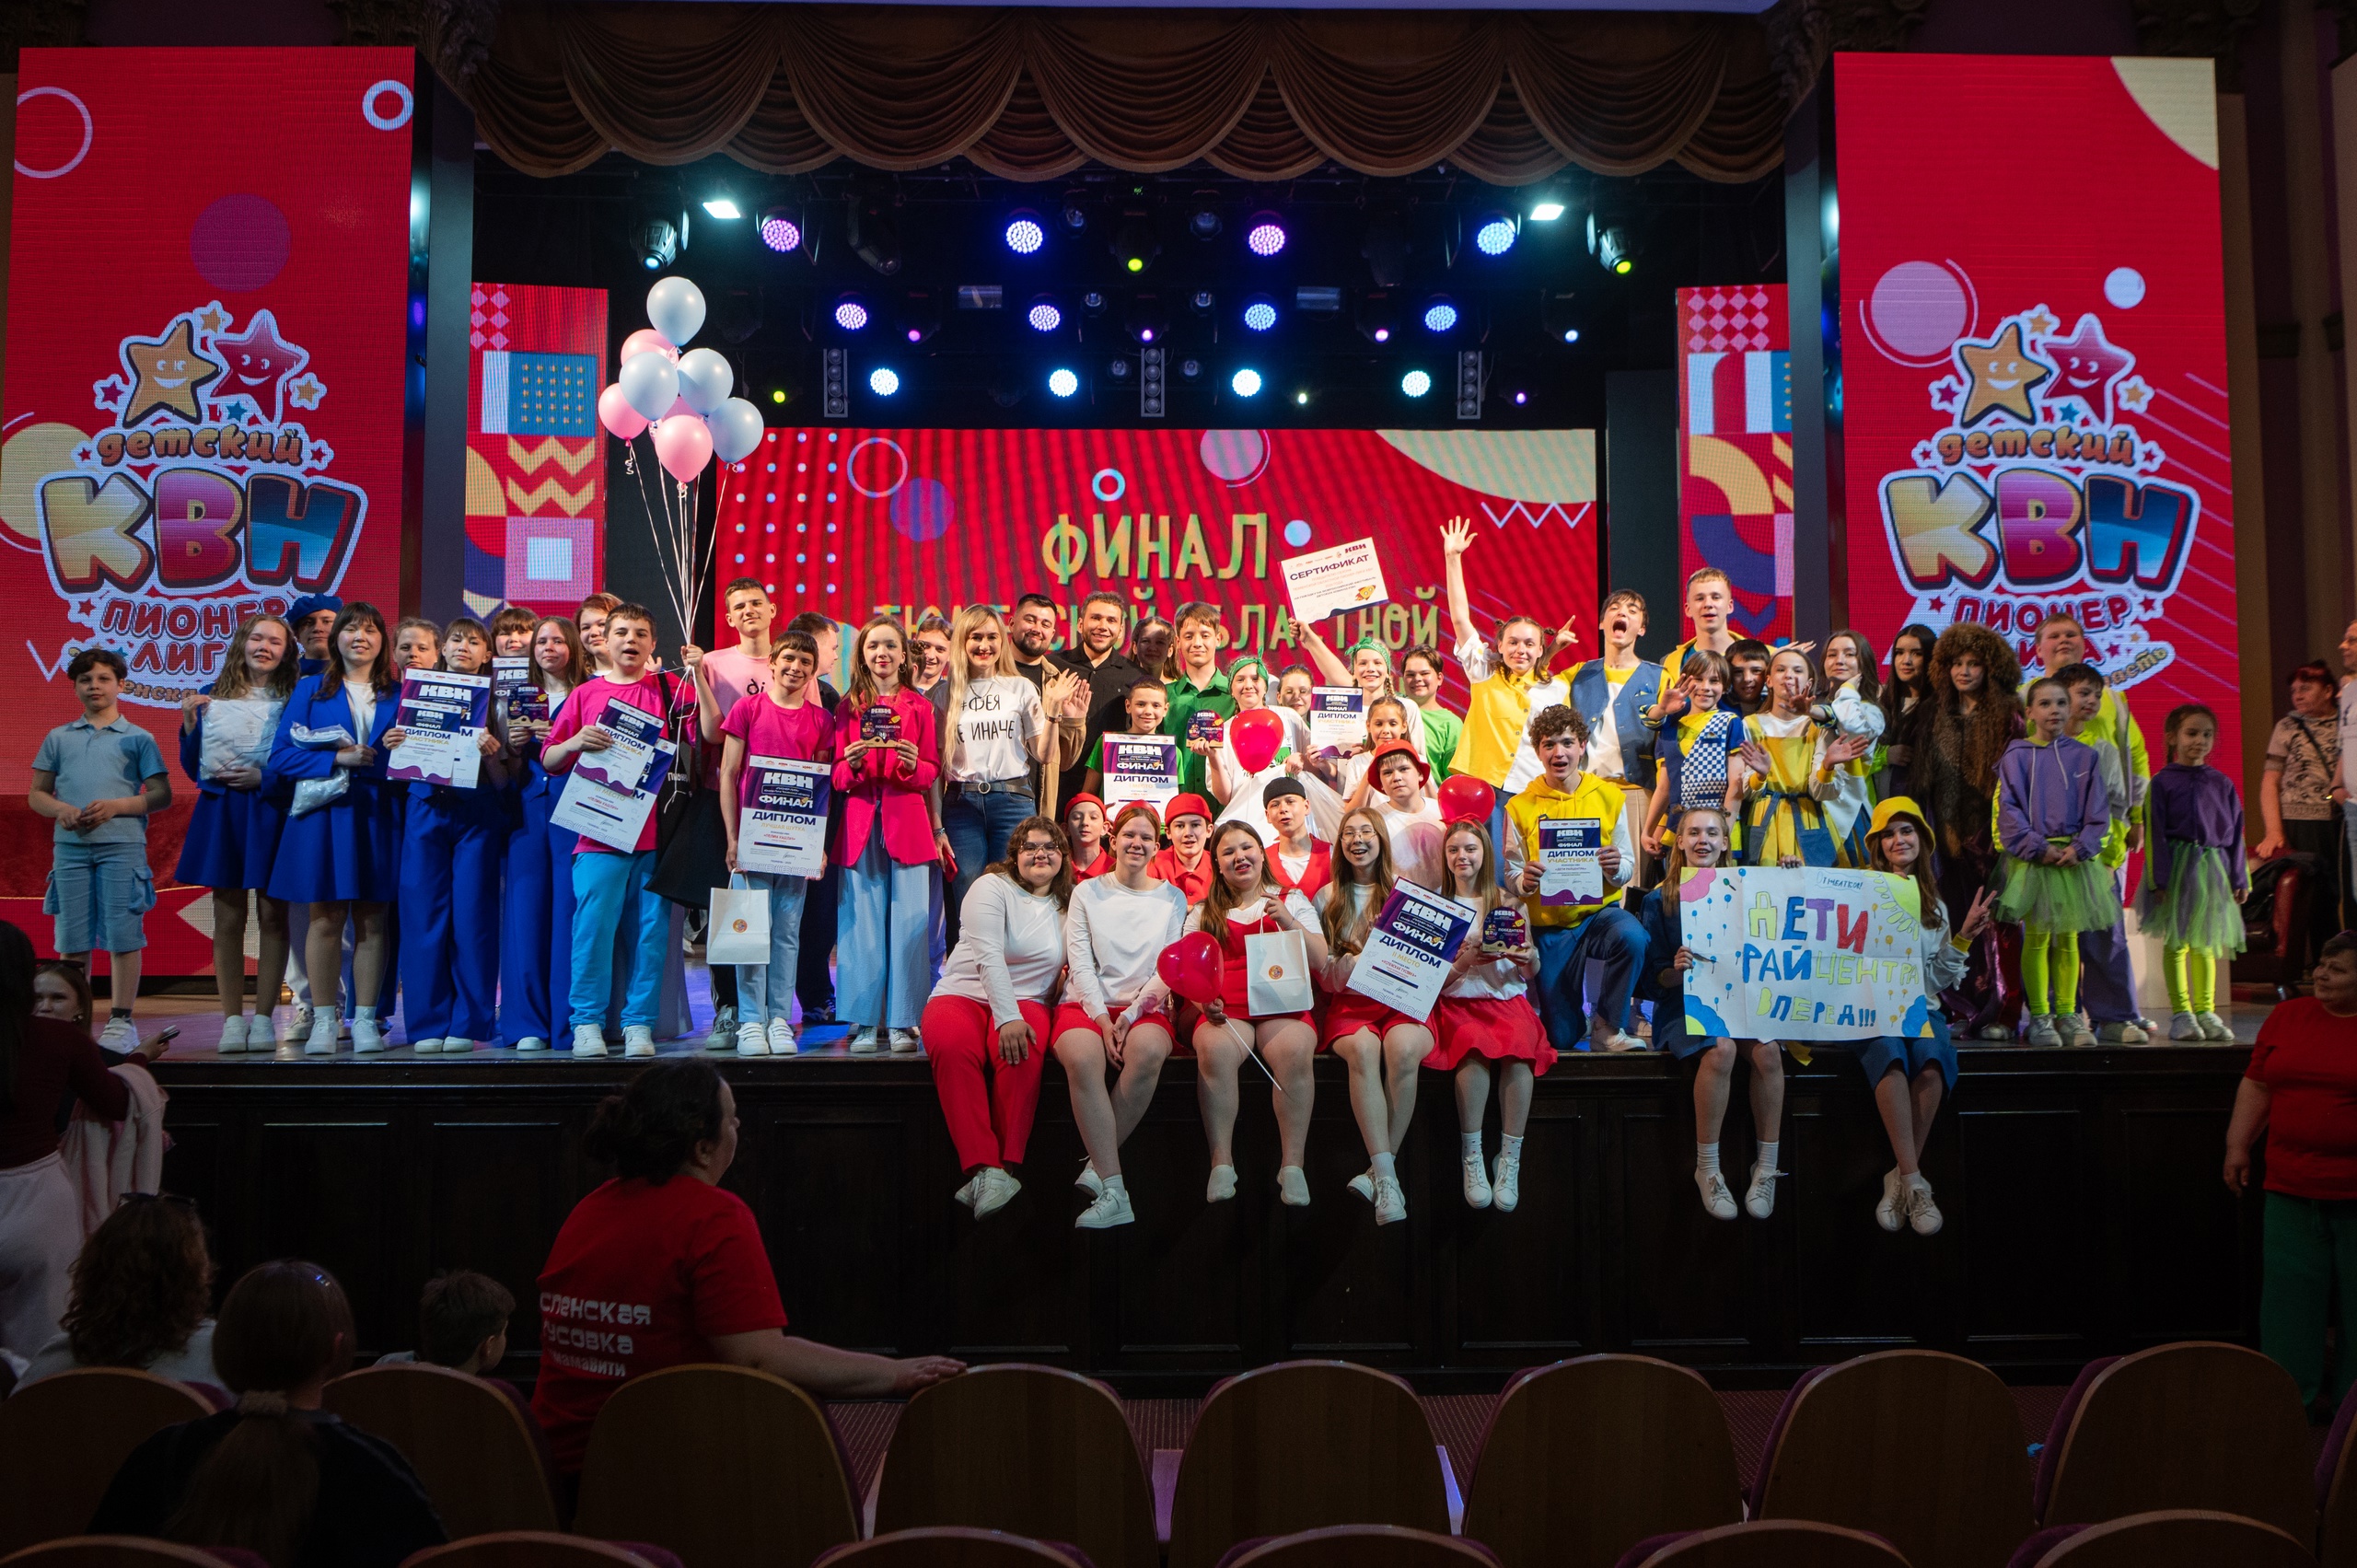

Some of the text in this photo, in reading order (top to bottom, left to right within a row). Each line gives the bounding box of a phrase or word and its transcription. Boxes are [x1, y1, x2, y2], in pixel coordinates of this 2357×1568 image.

[97, 424, 303, 466] детский
[1937, 426, 2135, 465] детский
[41, 468, 362, 594] КВН
[1886, 468, 2193, 593] КВН
[1041, 513, 1268, 585] ФИНАЛ
[1344, 543, 1366, 553] КВН
[1290, 554, 1369, 581] СЕРТИФИКАТ
[496, 669, 529, 681] КВ
[419, 684, 471, 702] КВН
[961, 694, 1001, 712] #ФЕЯ
[416, 710, 444, 719] КВН
[619, 714, 645, 729] КВН
[405, 728, 451, 739] ДИПЛОМ
[616, 726, 640, 738] ФИНАЛ
[970, 719, 1015, 741] ИНАЧЕ
[1118, 744, 1163, 756] КВН
[1117, 762, 1165, 771] ФИНАЛ
[762, 772, 813, 789] КВН
[1113, 775, 1169, 784] ДИПЛОМ
[602, 788, 626, 802] МЕСТО
[759, 795, 814, 808] ФИНАЛ
[752, 810, 817, 826] ДИПЛОМ
[1548, 850, 1595, 858] ДИПЛОМ
[1401, 899, 1453, 932] КВН
[1749, 891, 1868, 954] ДЕТИ
[1392, 921, 1446, 950] ФИНАЛ
[1379, 935, 1442, 969] ДИПЛОМ
[1398, 953, 1421, 969] МЕСТО
[1742, 943, 1920, 985] РАЙЦЕНТРА
[1757, 987, 1876, 1028] ВПЕРЕД!!!
